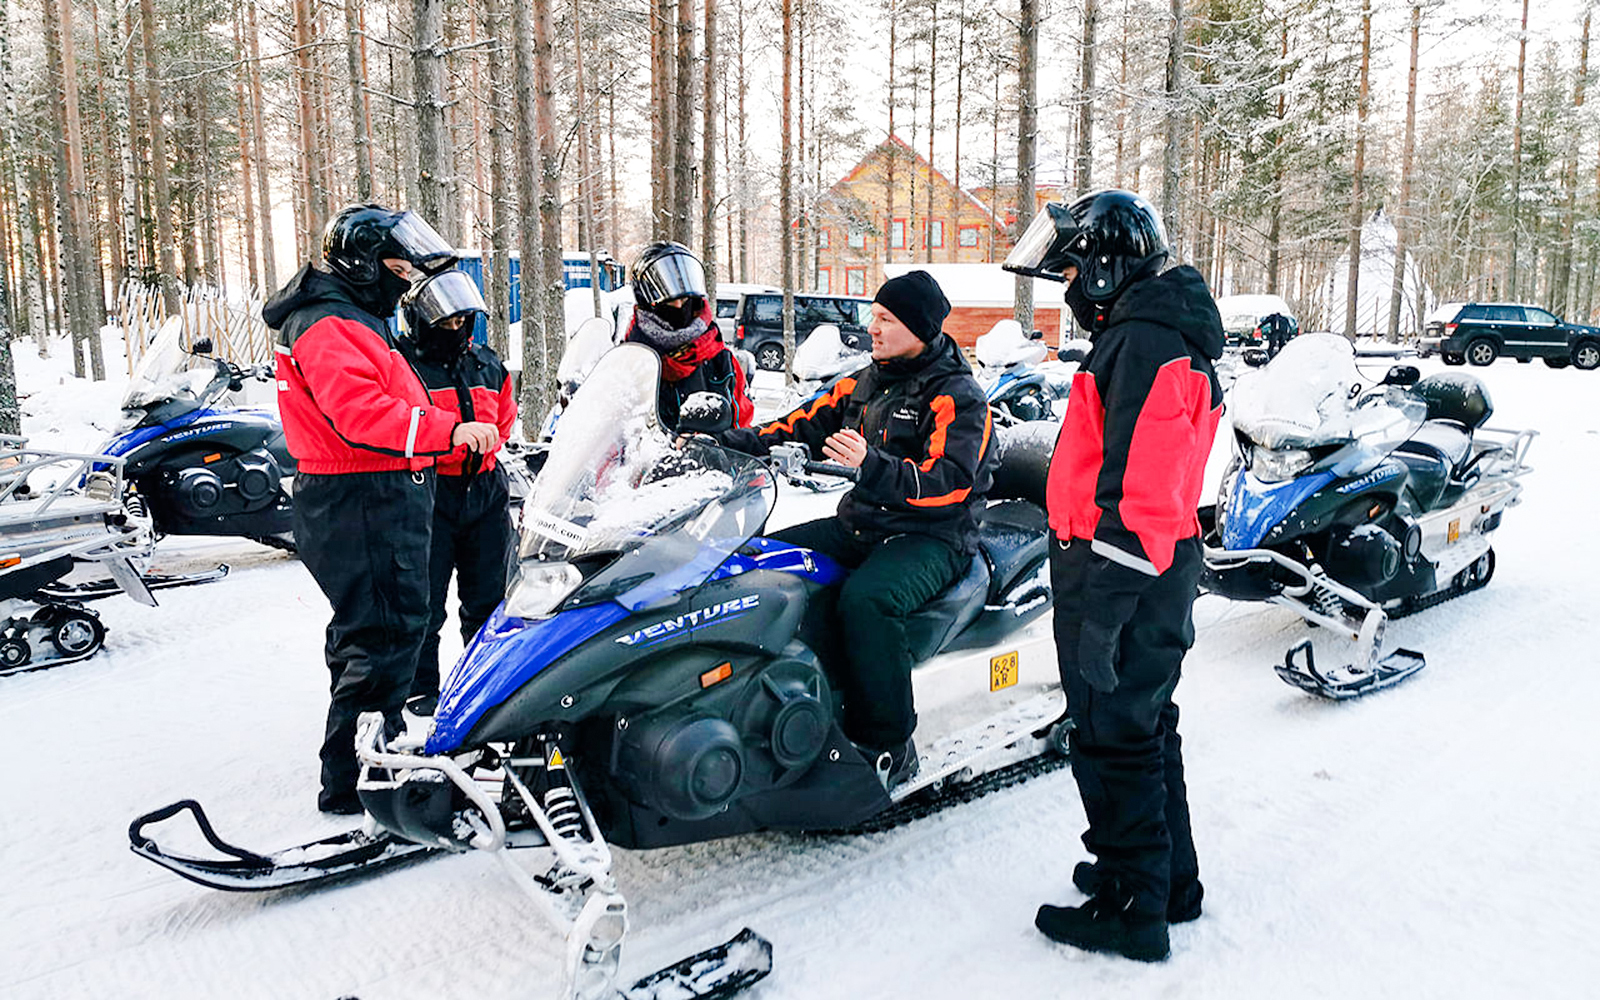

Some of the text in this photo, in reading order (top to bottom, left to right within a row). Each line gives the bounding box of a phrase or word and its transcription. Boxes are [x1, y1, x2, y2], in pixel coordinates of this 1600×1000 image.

[1347, 382, 1362, 400] 9
[614, 594, 760, 646] VENTURE
[994, 655, 1015, 672] 628
